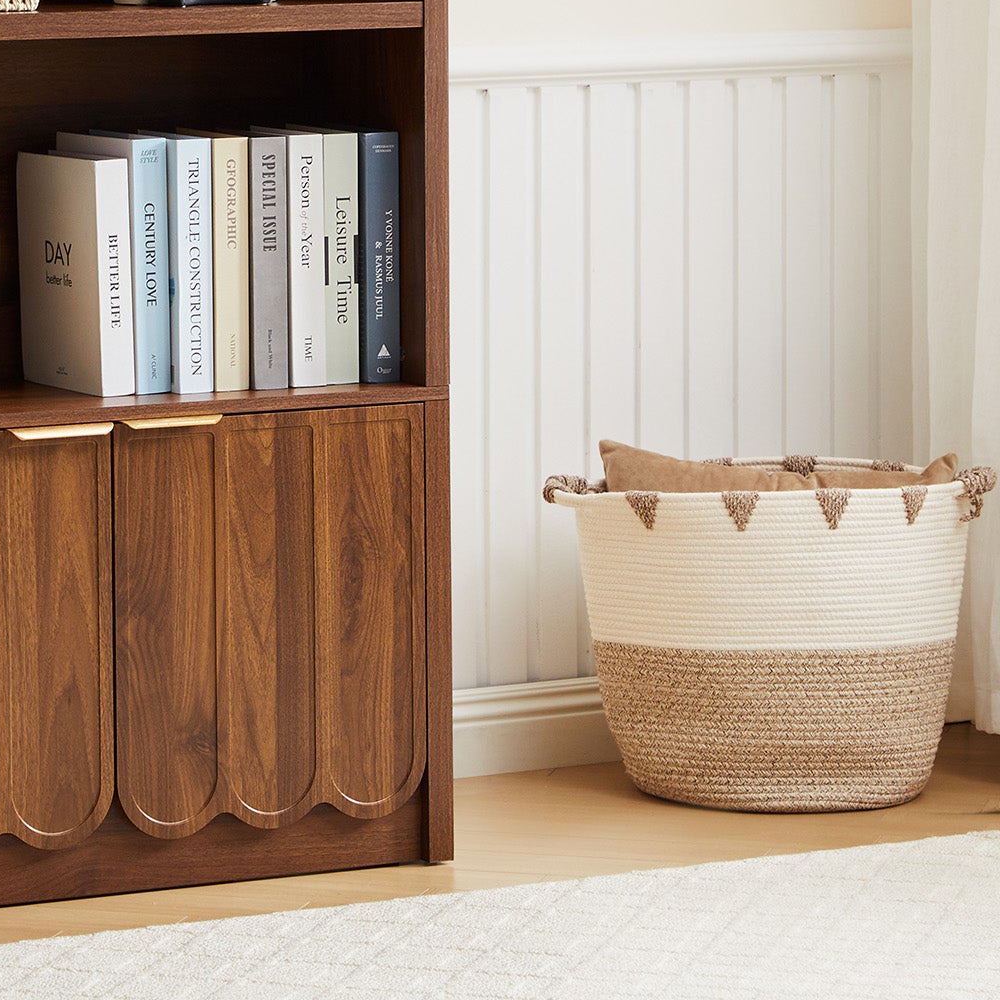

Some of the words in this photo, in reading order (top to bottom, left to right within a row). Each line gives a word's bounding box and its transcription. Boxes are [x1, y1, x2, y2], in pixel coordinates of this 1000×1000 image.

[188, 158, 200, 242] TRIANGLE
[226, 159, 236, 249] GEOGRAPHIC
[262, 154, 276, 210] SPECIAL
[301, 156, 312, 208] Person
[144, 202, 156, 267] CENTURY
[262, 216, 277, 252] ISSUE
[301, 210, 309, 220] of
[335, 196, 351, 265] Leisure
[385, 209, 393, 254] YVONNE
[45, 240, 72, 266] DAY
[108, 234, 120, 291] BETTER
[301, 234, 312, 268] Year
[146, 270, 157, 307] LOVE
[375, 255, 383, 294] RASMUS
[110, 294, 121, 329] LIFE
[188, 247, 202, 376] CONSTRUCTION
[337, 276, 352, 324] Time
[375, 295, 383, 320] JUUL
